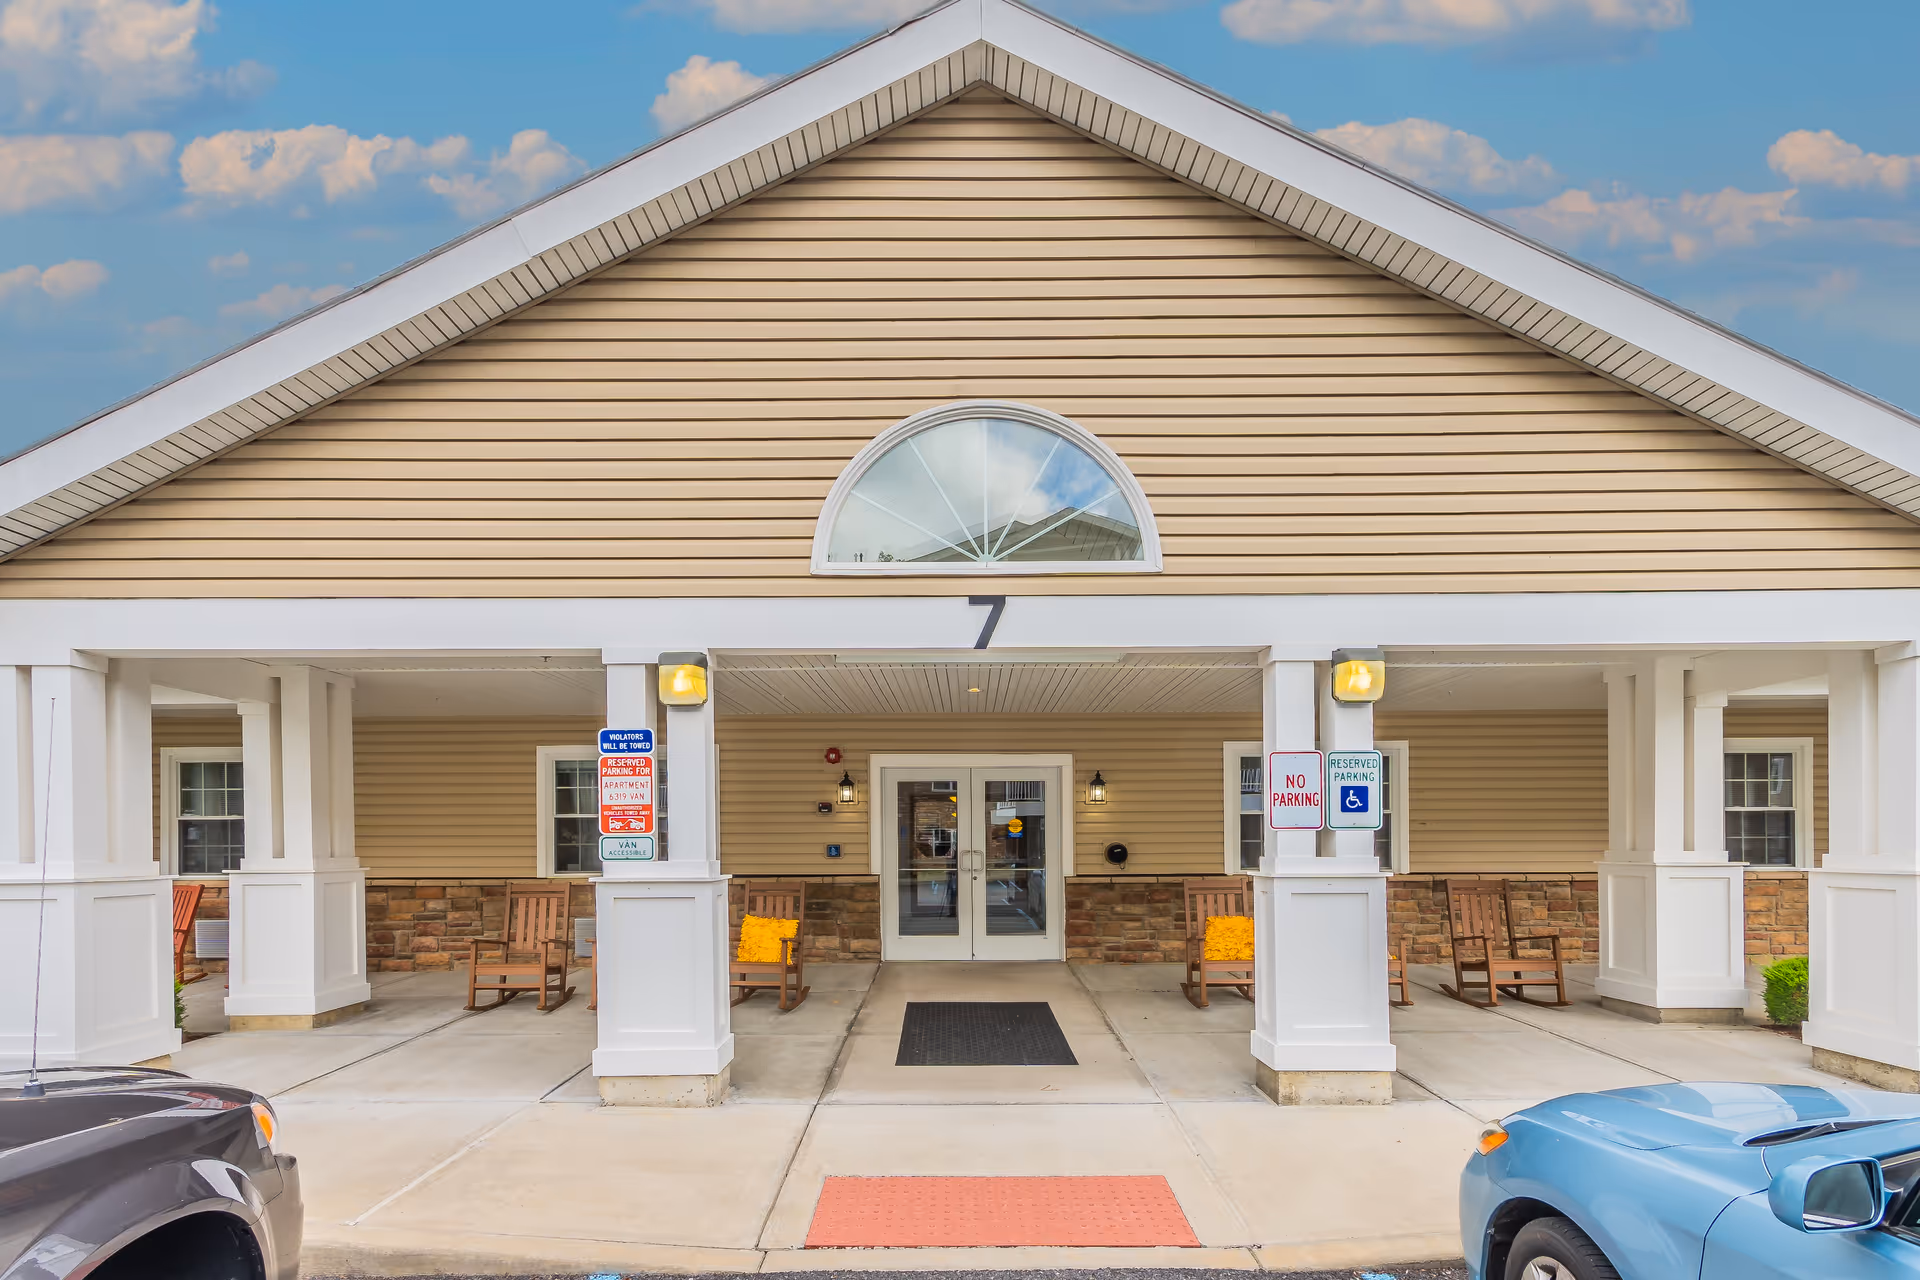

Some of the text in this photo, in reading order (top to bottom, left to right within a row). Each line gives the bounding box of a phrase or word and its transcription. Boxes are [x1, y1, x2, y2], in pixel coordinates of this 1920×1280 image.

[969, 595, 1006, 649] 7
[608, 758, 646, 766] RESERVED
[1330, 758, 1378, 768] RESERVED
[602, 767, 650, 776] PARKING FOR
[1286, 774, 1306, 788] NO
[1334, 772, 1375, 782] PARKING
[604, 781, 650, 789] APARTMENT
[1273, 792, 1320, 806] PARKING
